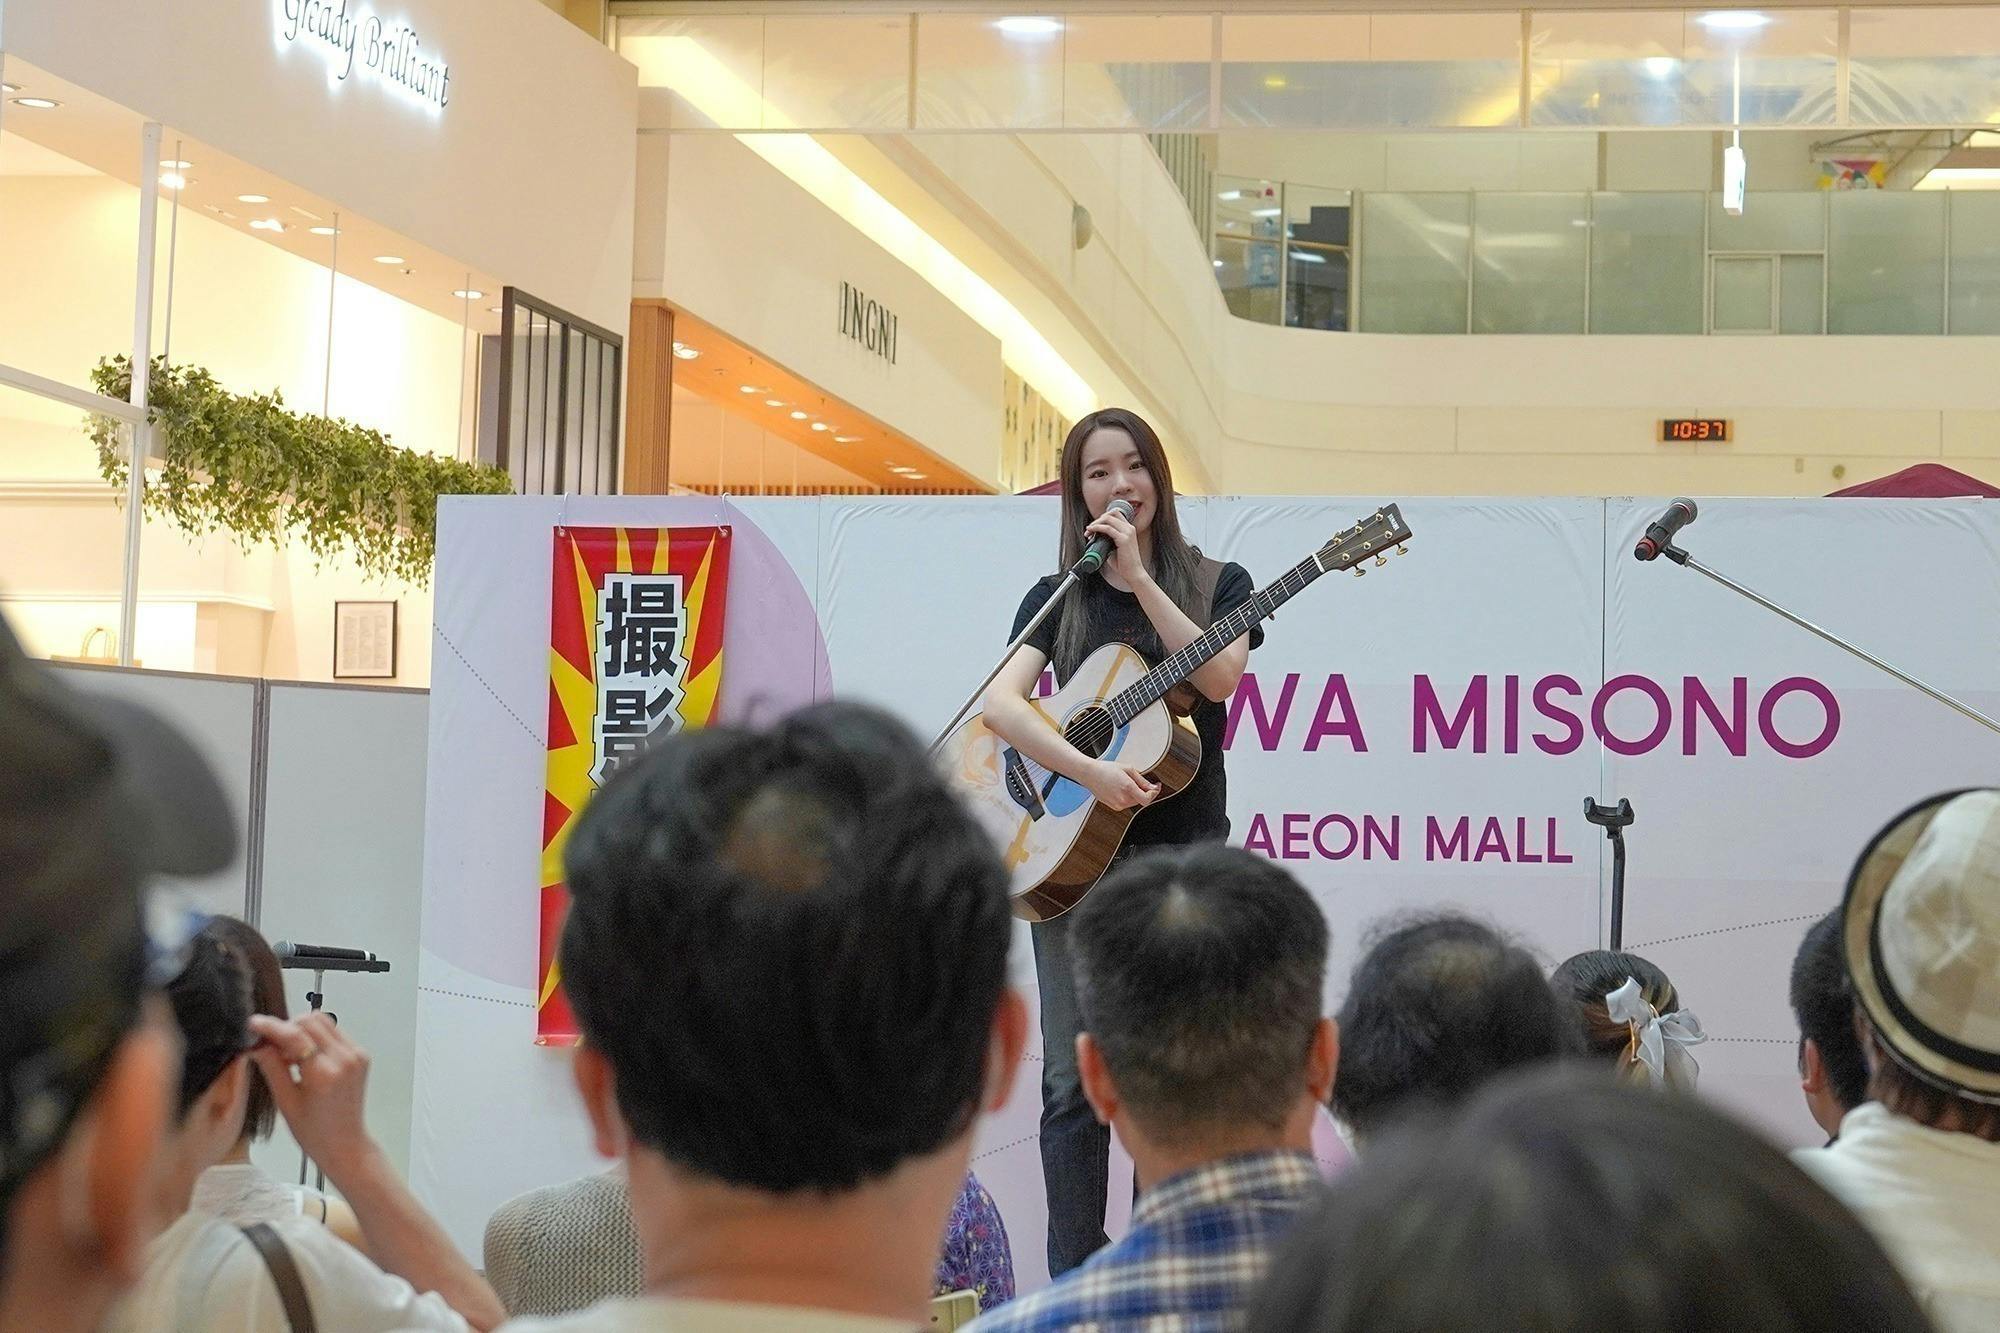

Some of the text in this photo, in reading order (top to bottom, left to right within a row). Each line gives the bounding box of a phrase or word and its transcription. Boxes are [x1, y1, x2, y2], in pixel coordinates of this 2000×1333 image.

[363, 16, 449, 108] Brilliant
[842, 281, 897, 364] INGNI
[1672, 421, 1723, 438] 10:37
[1412, 674, 1841, 759] MISONO
[1243, 813, 1574, 863] AEON MALL
